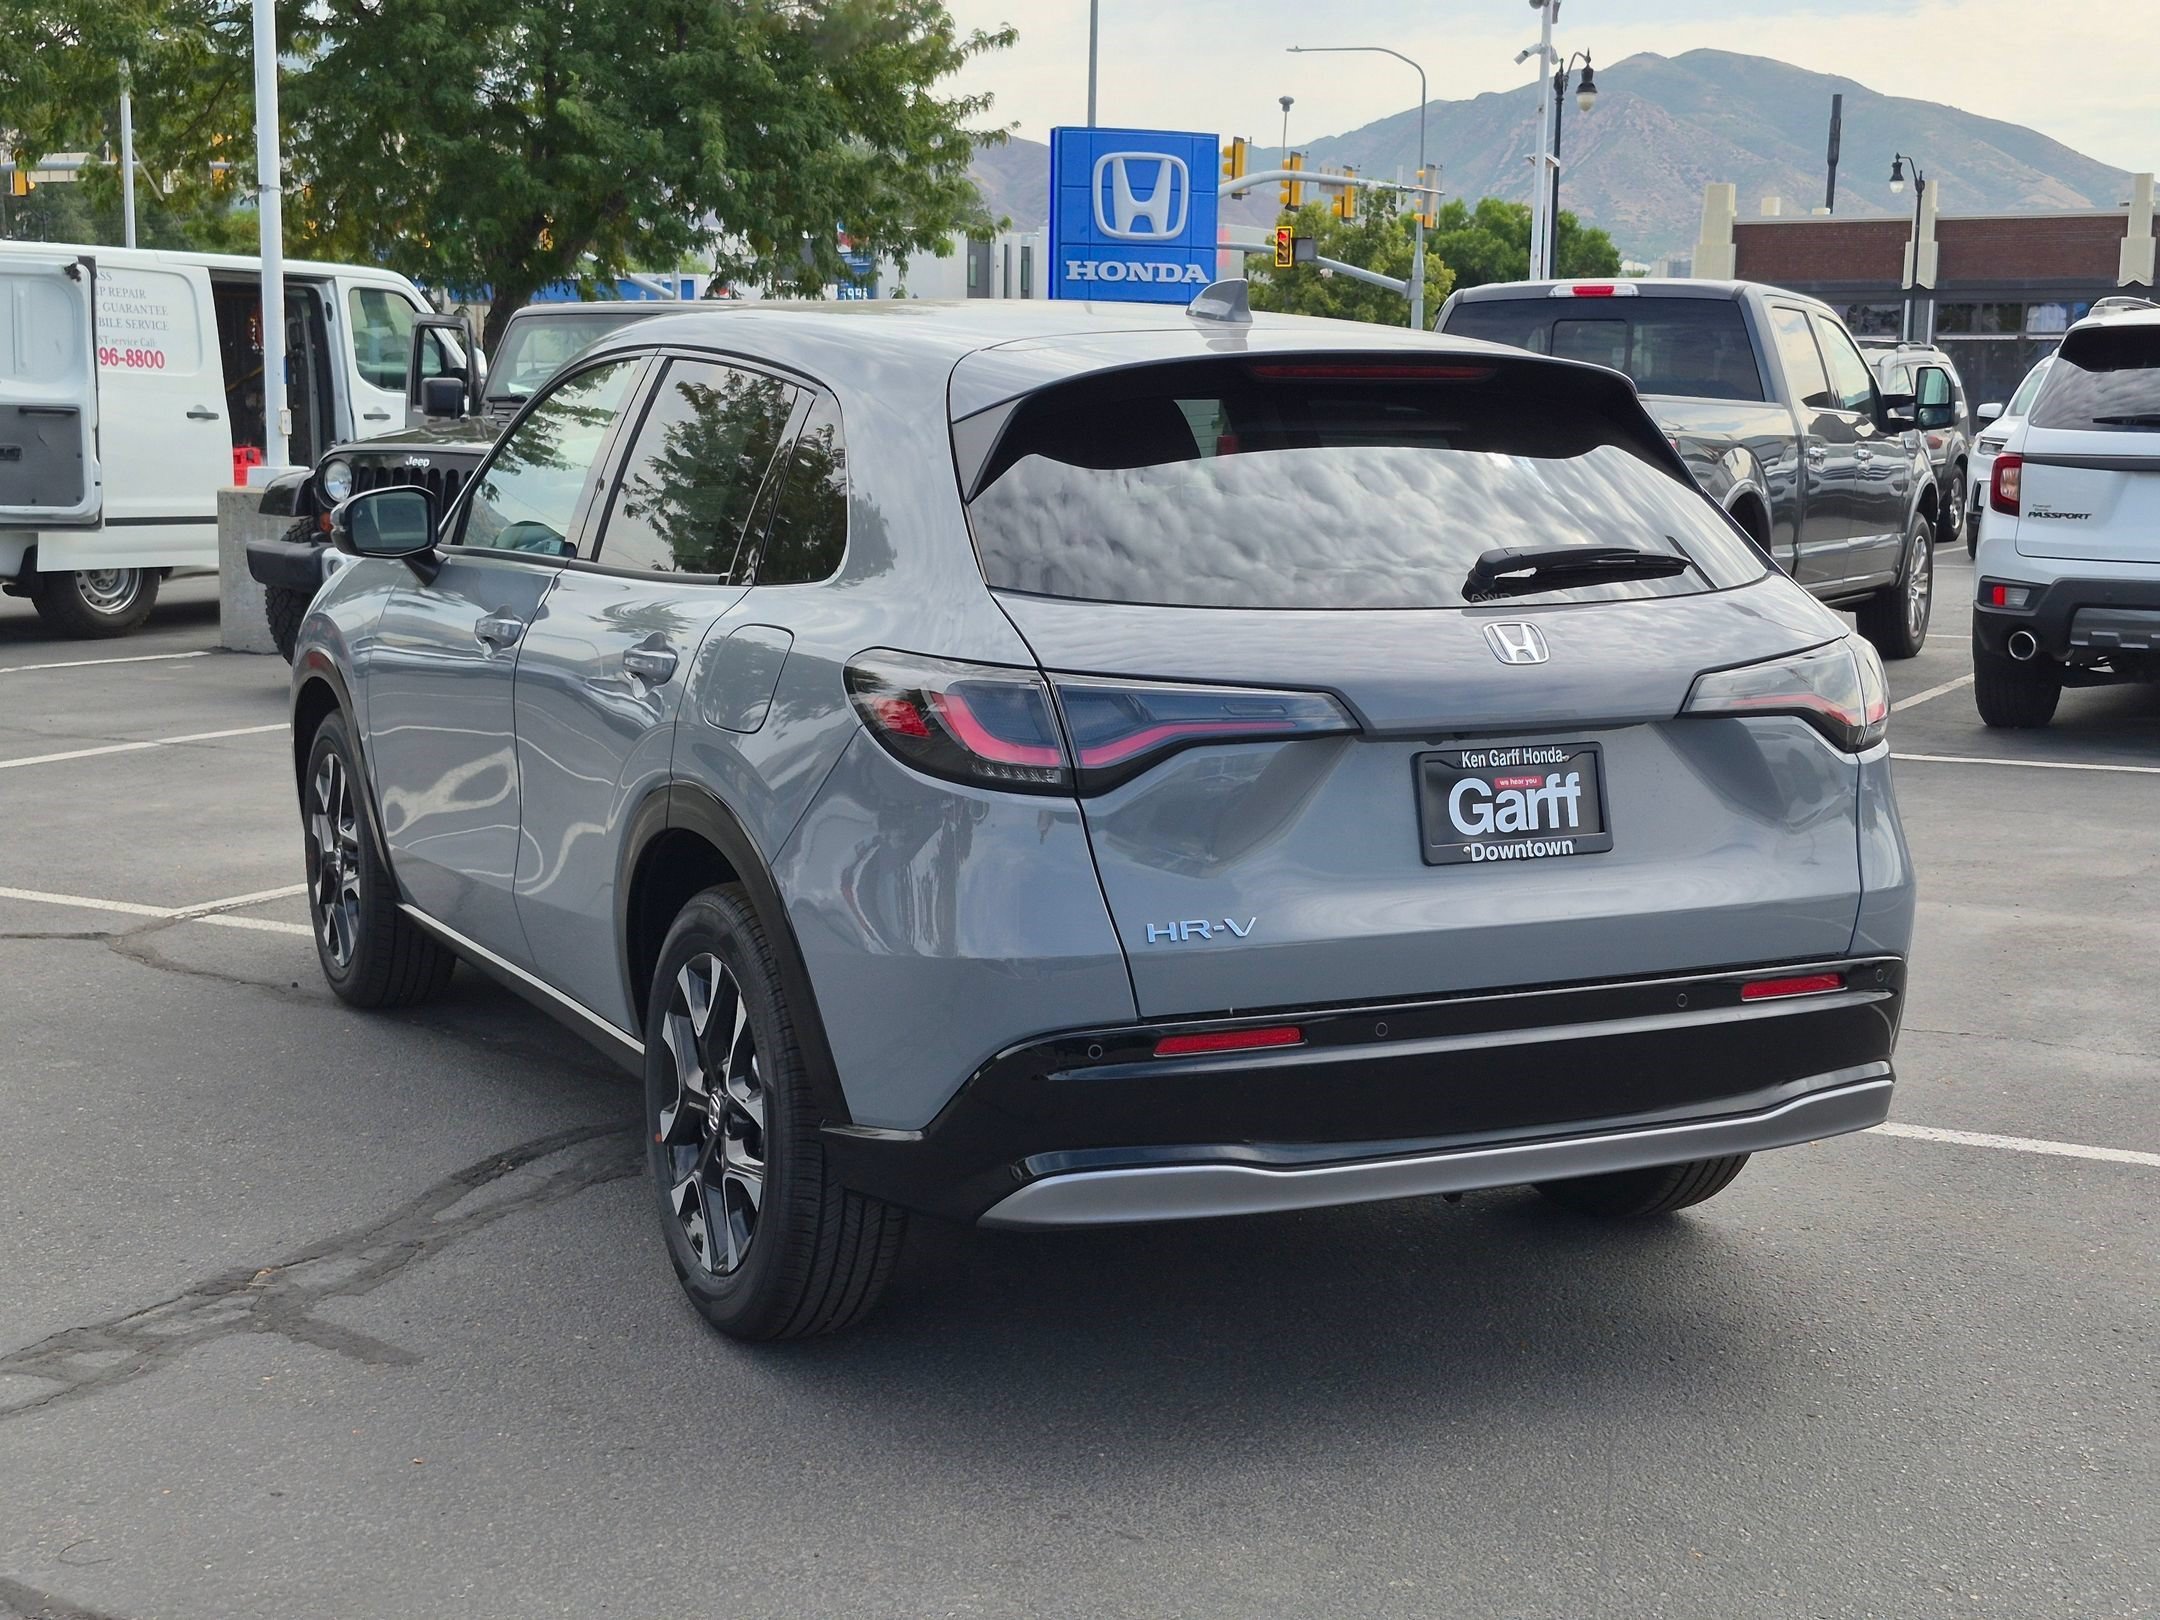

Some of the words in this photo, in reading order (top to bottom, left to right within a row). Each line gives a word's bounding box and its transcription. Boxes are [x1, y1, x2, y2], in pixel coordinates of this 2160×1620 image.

[1065, 260, 1210, 284] HONDA
[108, 287, 146, 299] REPAIR
[102, 302, 168, 316] GUARANTEE
[125, 319, 168, 331] SERVICE
[111, 337, 138, 347] service
[98, 347, 165, 369] 96-8800
[405, 455, 430, 468] Jeep
[2027, 511, 2092, 520] PASSPORT
[1461, 751, 1486, 768] Ken
[1489, 749, 1520, 766] Garff
[1523, 747, 1563, 764] Honda
[1525, 777, 1538, 785] you
[1448, 772, 1581, 836] Garff
[1470, 839, 1574, 862] Downtown
[1146, 916, 1257, 943] HR-V
